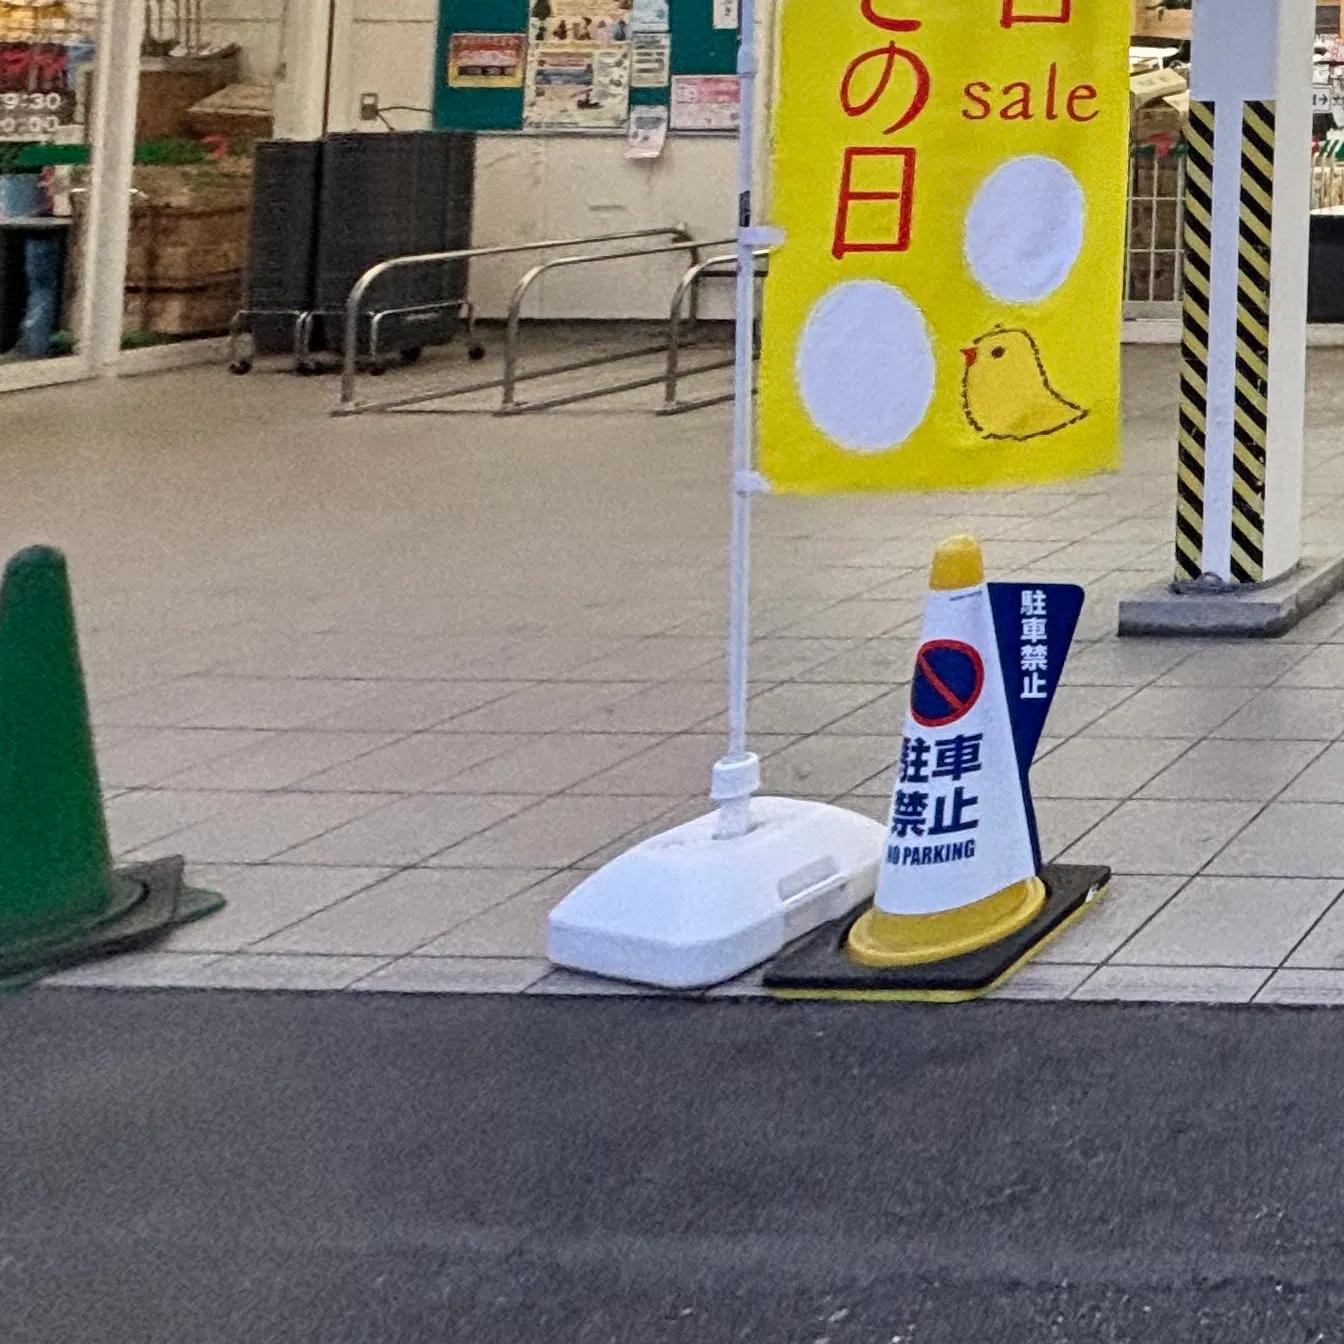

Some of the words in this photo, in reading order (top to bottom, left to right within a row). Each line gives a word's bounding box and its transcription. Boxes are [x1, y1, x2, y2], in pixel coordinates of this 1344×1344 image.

[961, 61, 1099, 123] sale
[1020, 590, 1048, 699] 駐車禁止
[901, 732, 983, 784] 駐車
[891, 786, 979, 838] 禁止
[903, 839, 976, 866] PARKING
